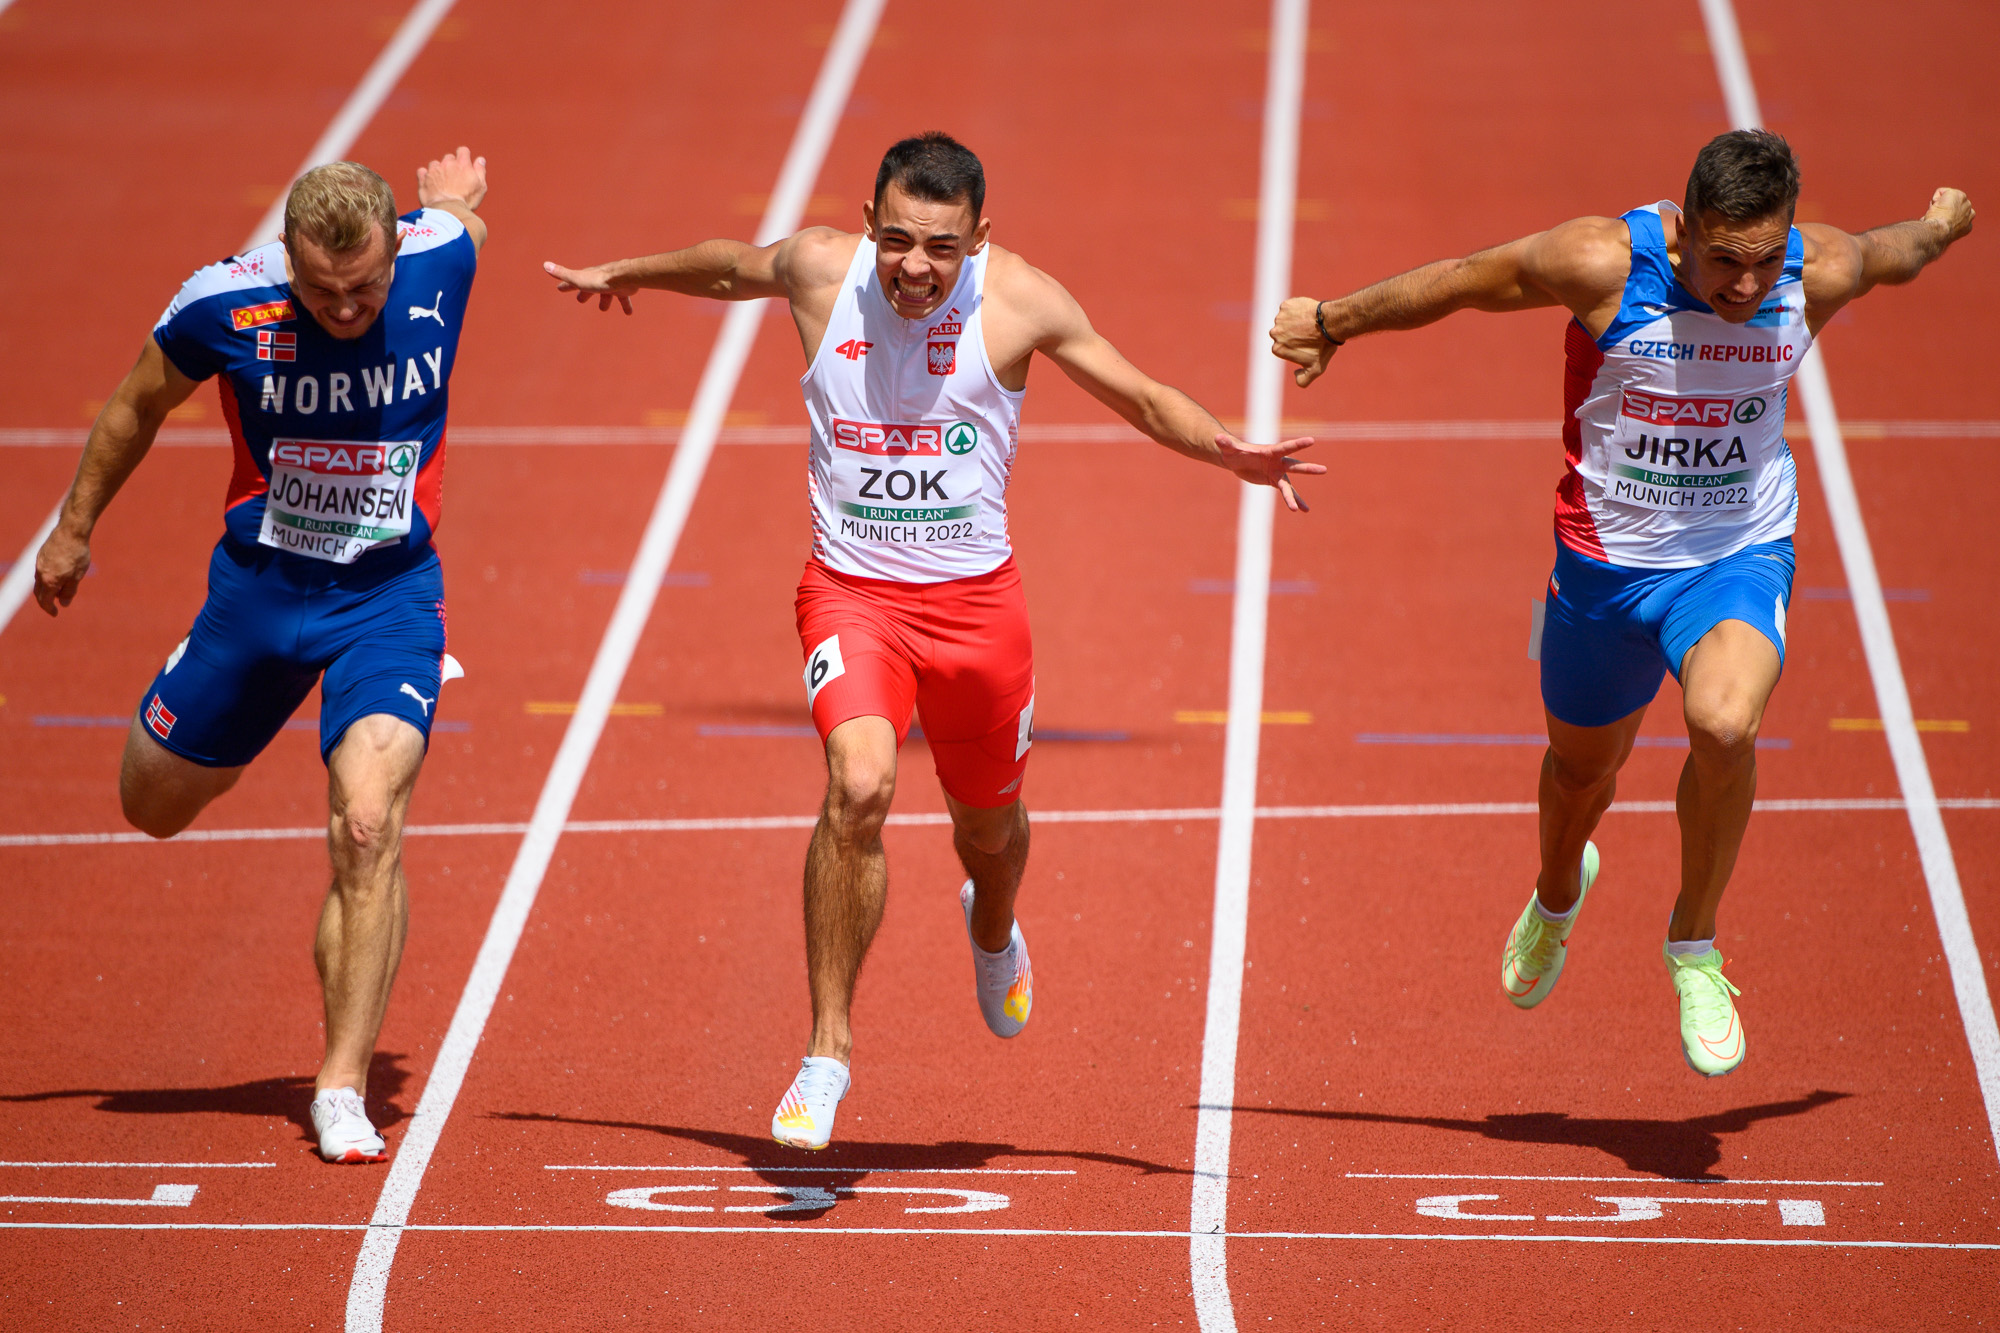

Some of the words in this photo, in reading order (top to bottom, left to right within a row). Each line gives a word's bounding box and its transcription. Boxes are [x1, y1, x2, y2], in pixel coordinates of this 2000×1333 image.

[255, 306, 292, 321] EXTRA
[835, 339, 874, 361] 4F
[1629, 339, 1695, 361] CZECH
[1699, 343, 1794, 363] REPUBLIC
[260, 346, 443, 415] NORWAY
[1625, 396, 1731, 423] SPAR
[835, 422, 940, 452] SPAR
[1624, 433, 1748, 468] JIRKA
[277, 444, 385, 472] SPAR
[858, 467, 949, 502] ZOK
[1643, 471, 1648, 482] I
[1650, 473, 1679, 486] RUN
[272, 473, 407, 520] JOHANSEN
[1614, 480, 1695, 507] MUNICH
[1702, 486, 1748, 507] 2022
[297, 517, 302, 528] I
[304, 518, 332, 532] RUN
[863, 507, 868, 518] I
[870, 508, 898, 520] RUN
[270, 524, 348, 557] MUNICH
[840, 518, 917, 543] MUNICH
[925, 521, 974, 543] 2022
[811, 649, 829, 690] 6
[1415, 1194, 1826, 1226] 5
